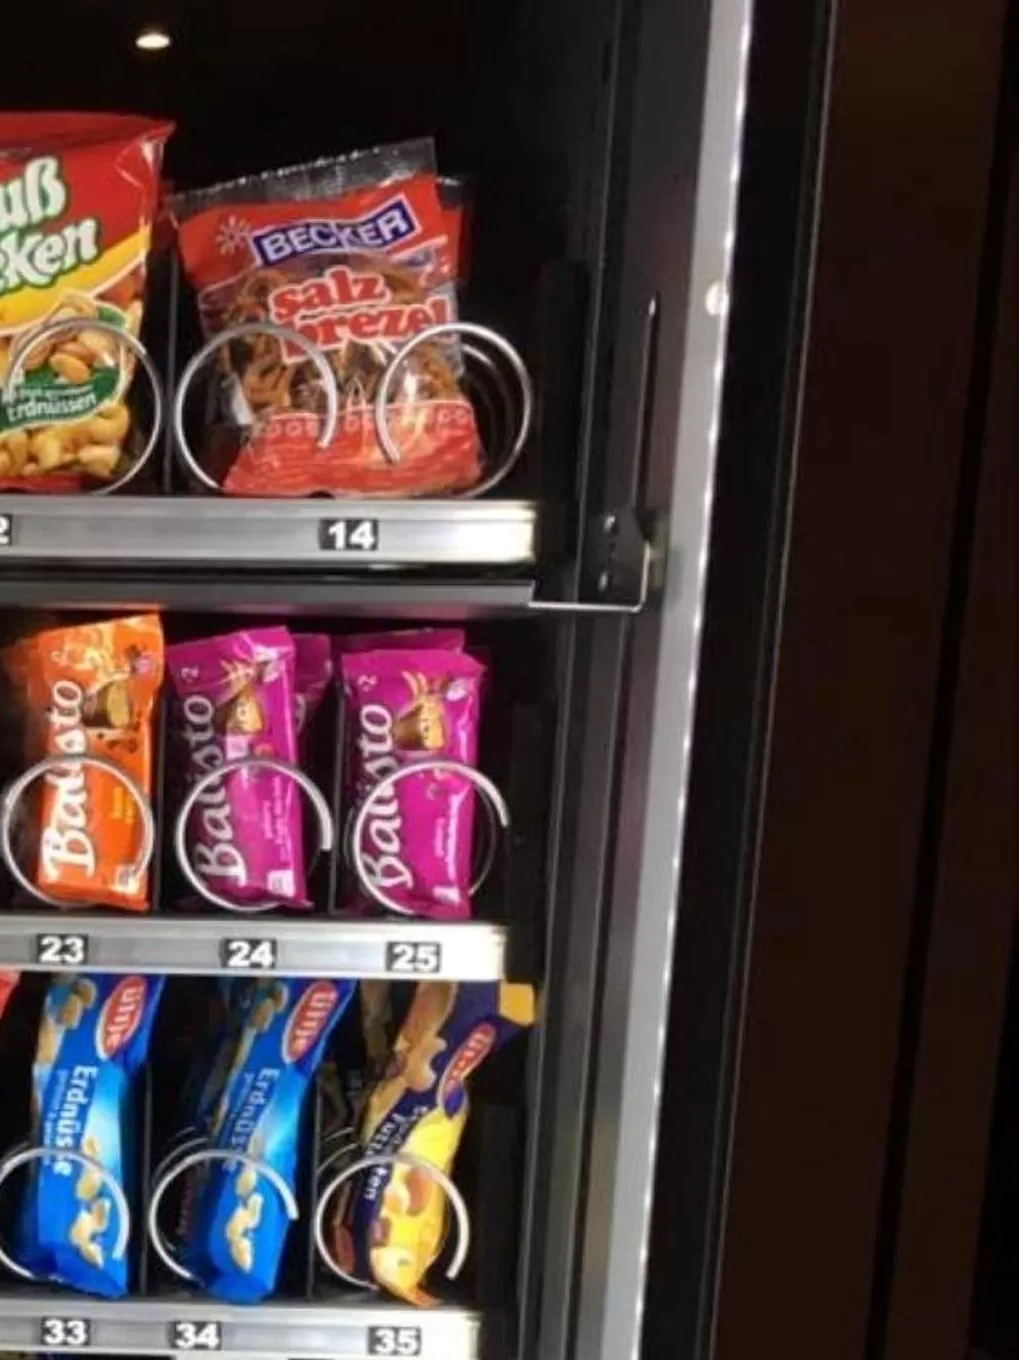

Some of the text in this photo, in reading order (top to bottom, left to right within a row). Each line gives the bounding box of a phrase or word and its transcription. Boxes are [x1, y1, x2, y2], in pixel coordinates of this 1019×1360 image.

[260, 203, 411, 263] BECKER
[328, 520, 375, 550] 14
[40, 938, 84, 963] 23
[230, 943, 275, 968] 24
[393, 946, 438, 971] 25
[44, 1321, 86, 1345] 33
[175, 1324, 220, 1349] 34
[373, 1329, 418, 1354] 35
